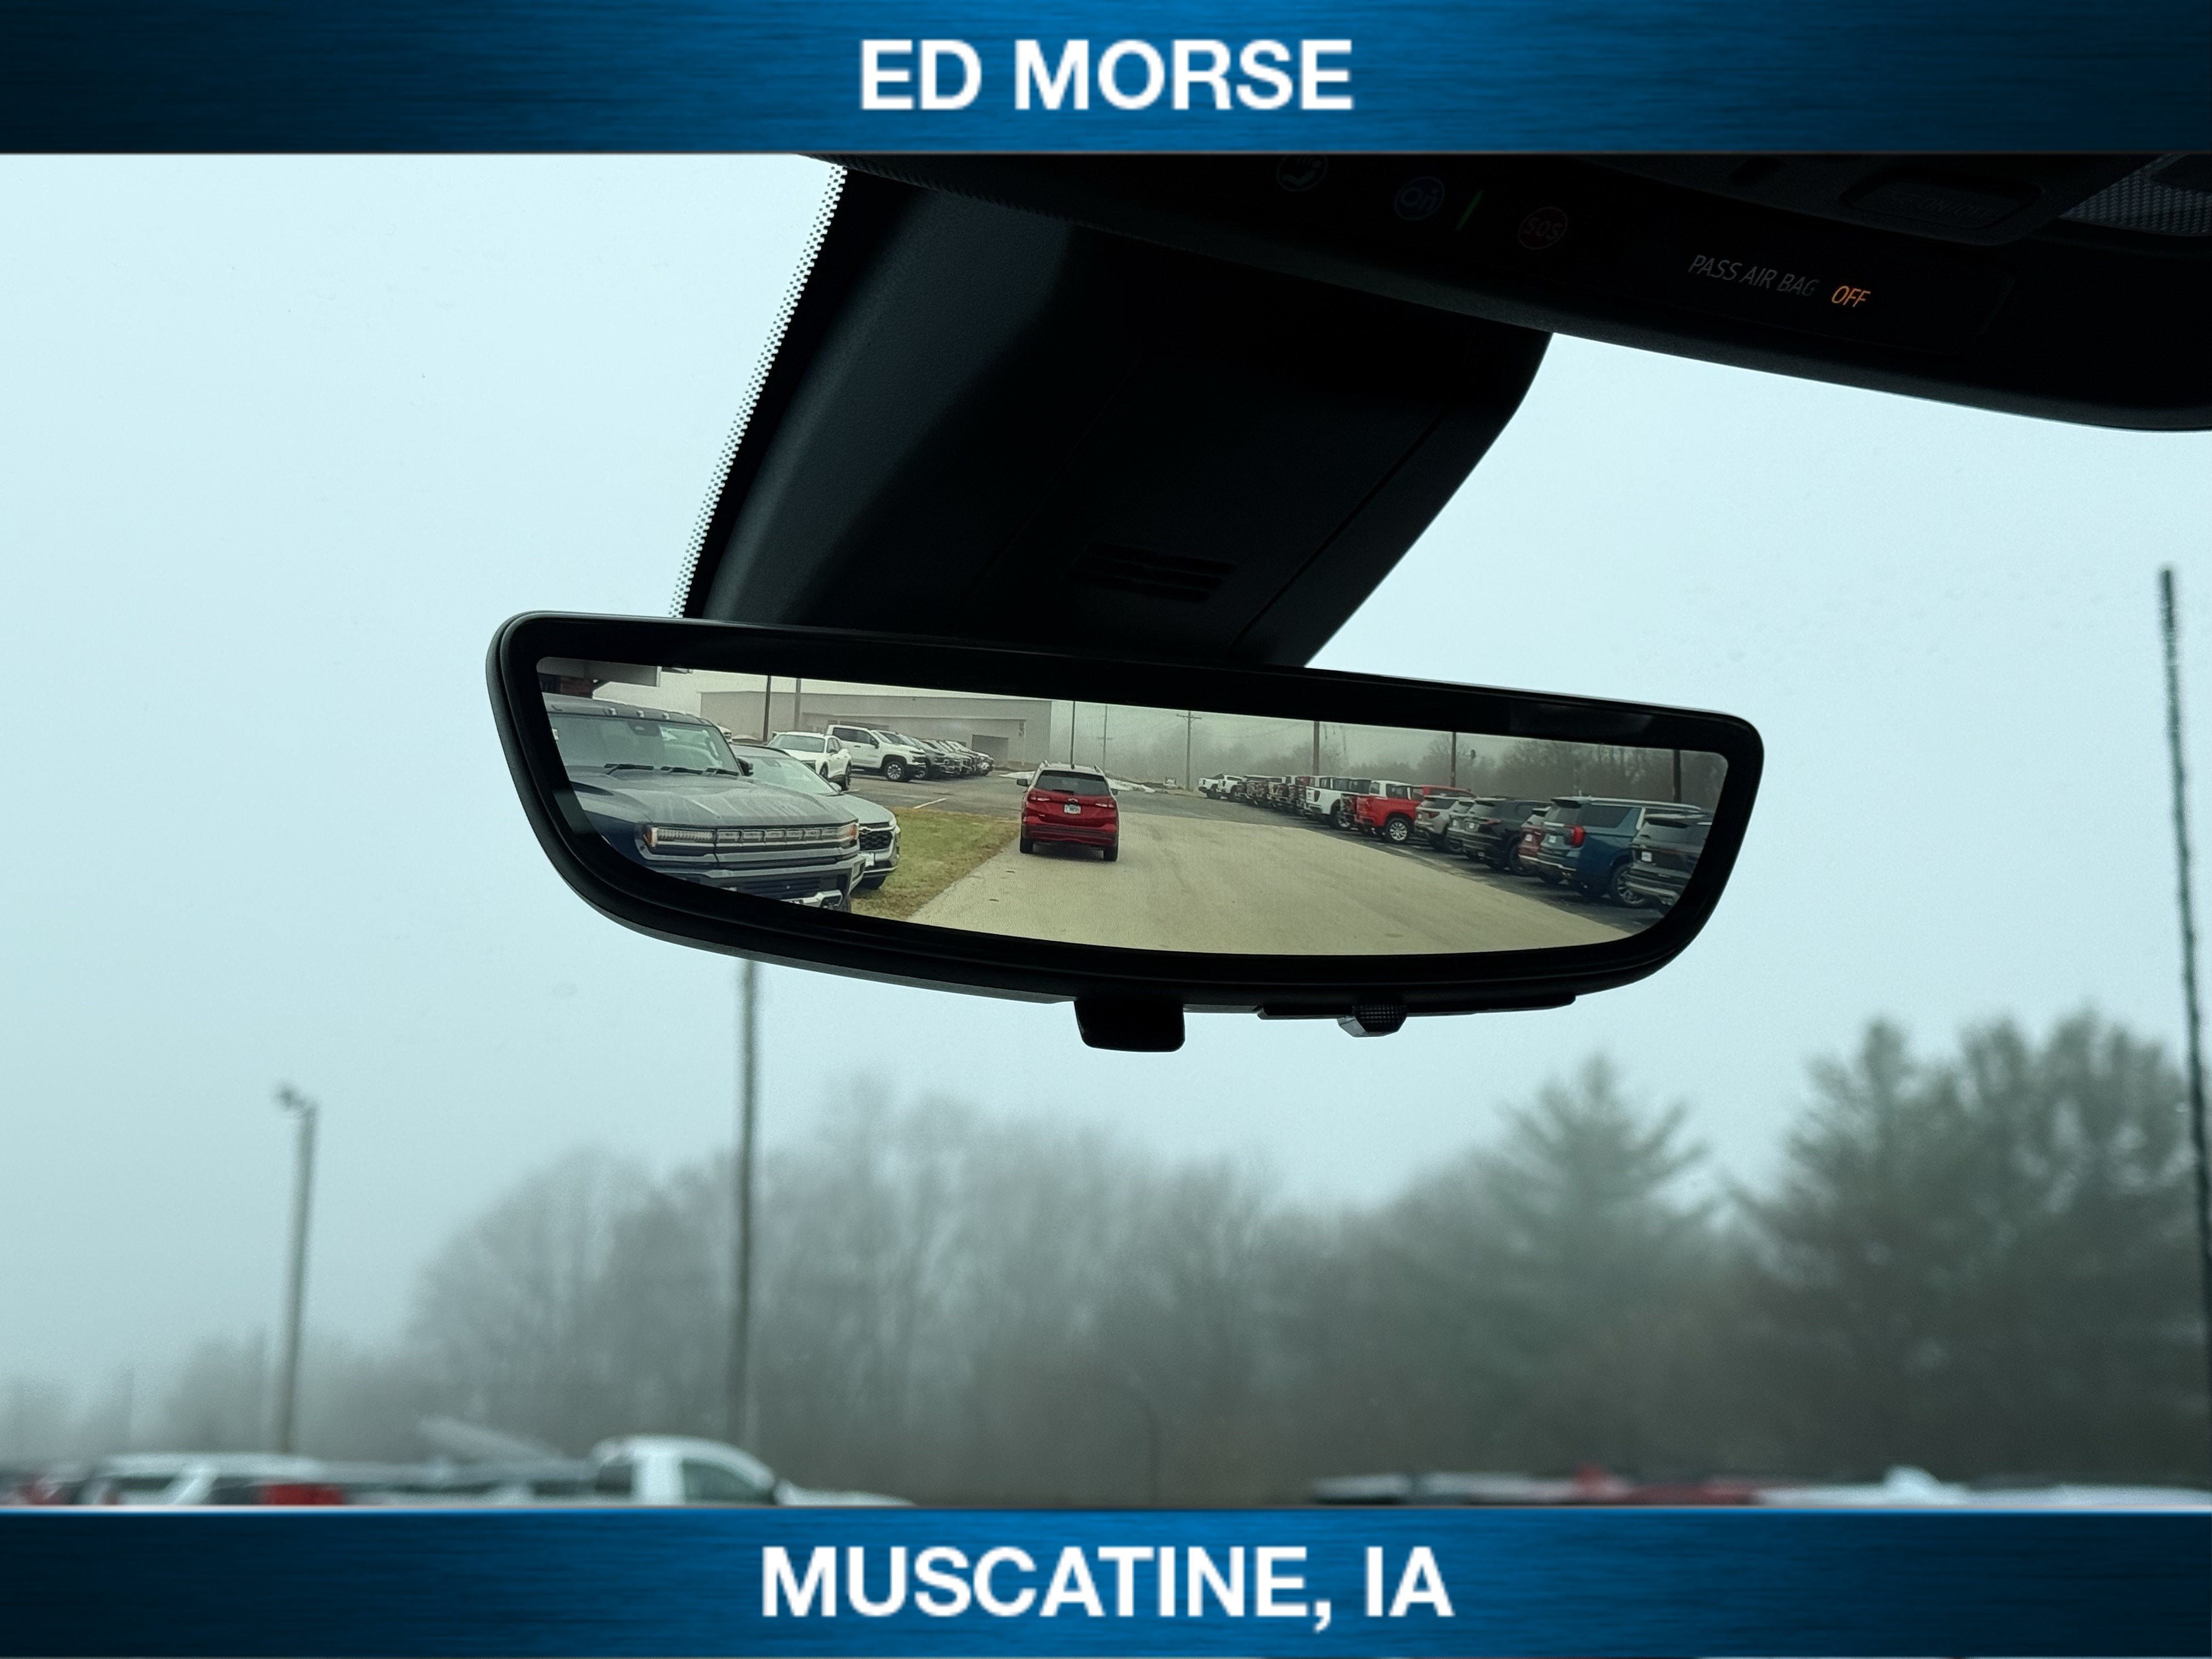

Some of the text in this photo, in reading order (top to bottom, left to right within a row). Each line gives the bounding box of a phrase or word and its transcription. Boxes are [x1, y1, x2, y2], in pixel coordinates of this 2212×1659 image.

[1522, 217, 1563, 240] SOS
[1687, 254, 1872, 308] PASS AIR BAG OFF
